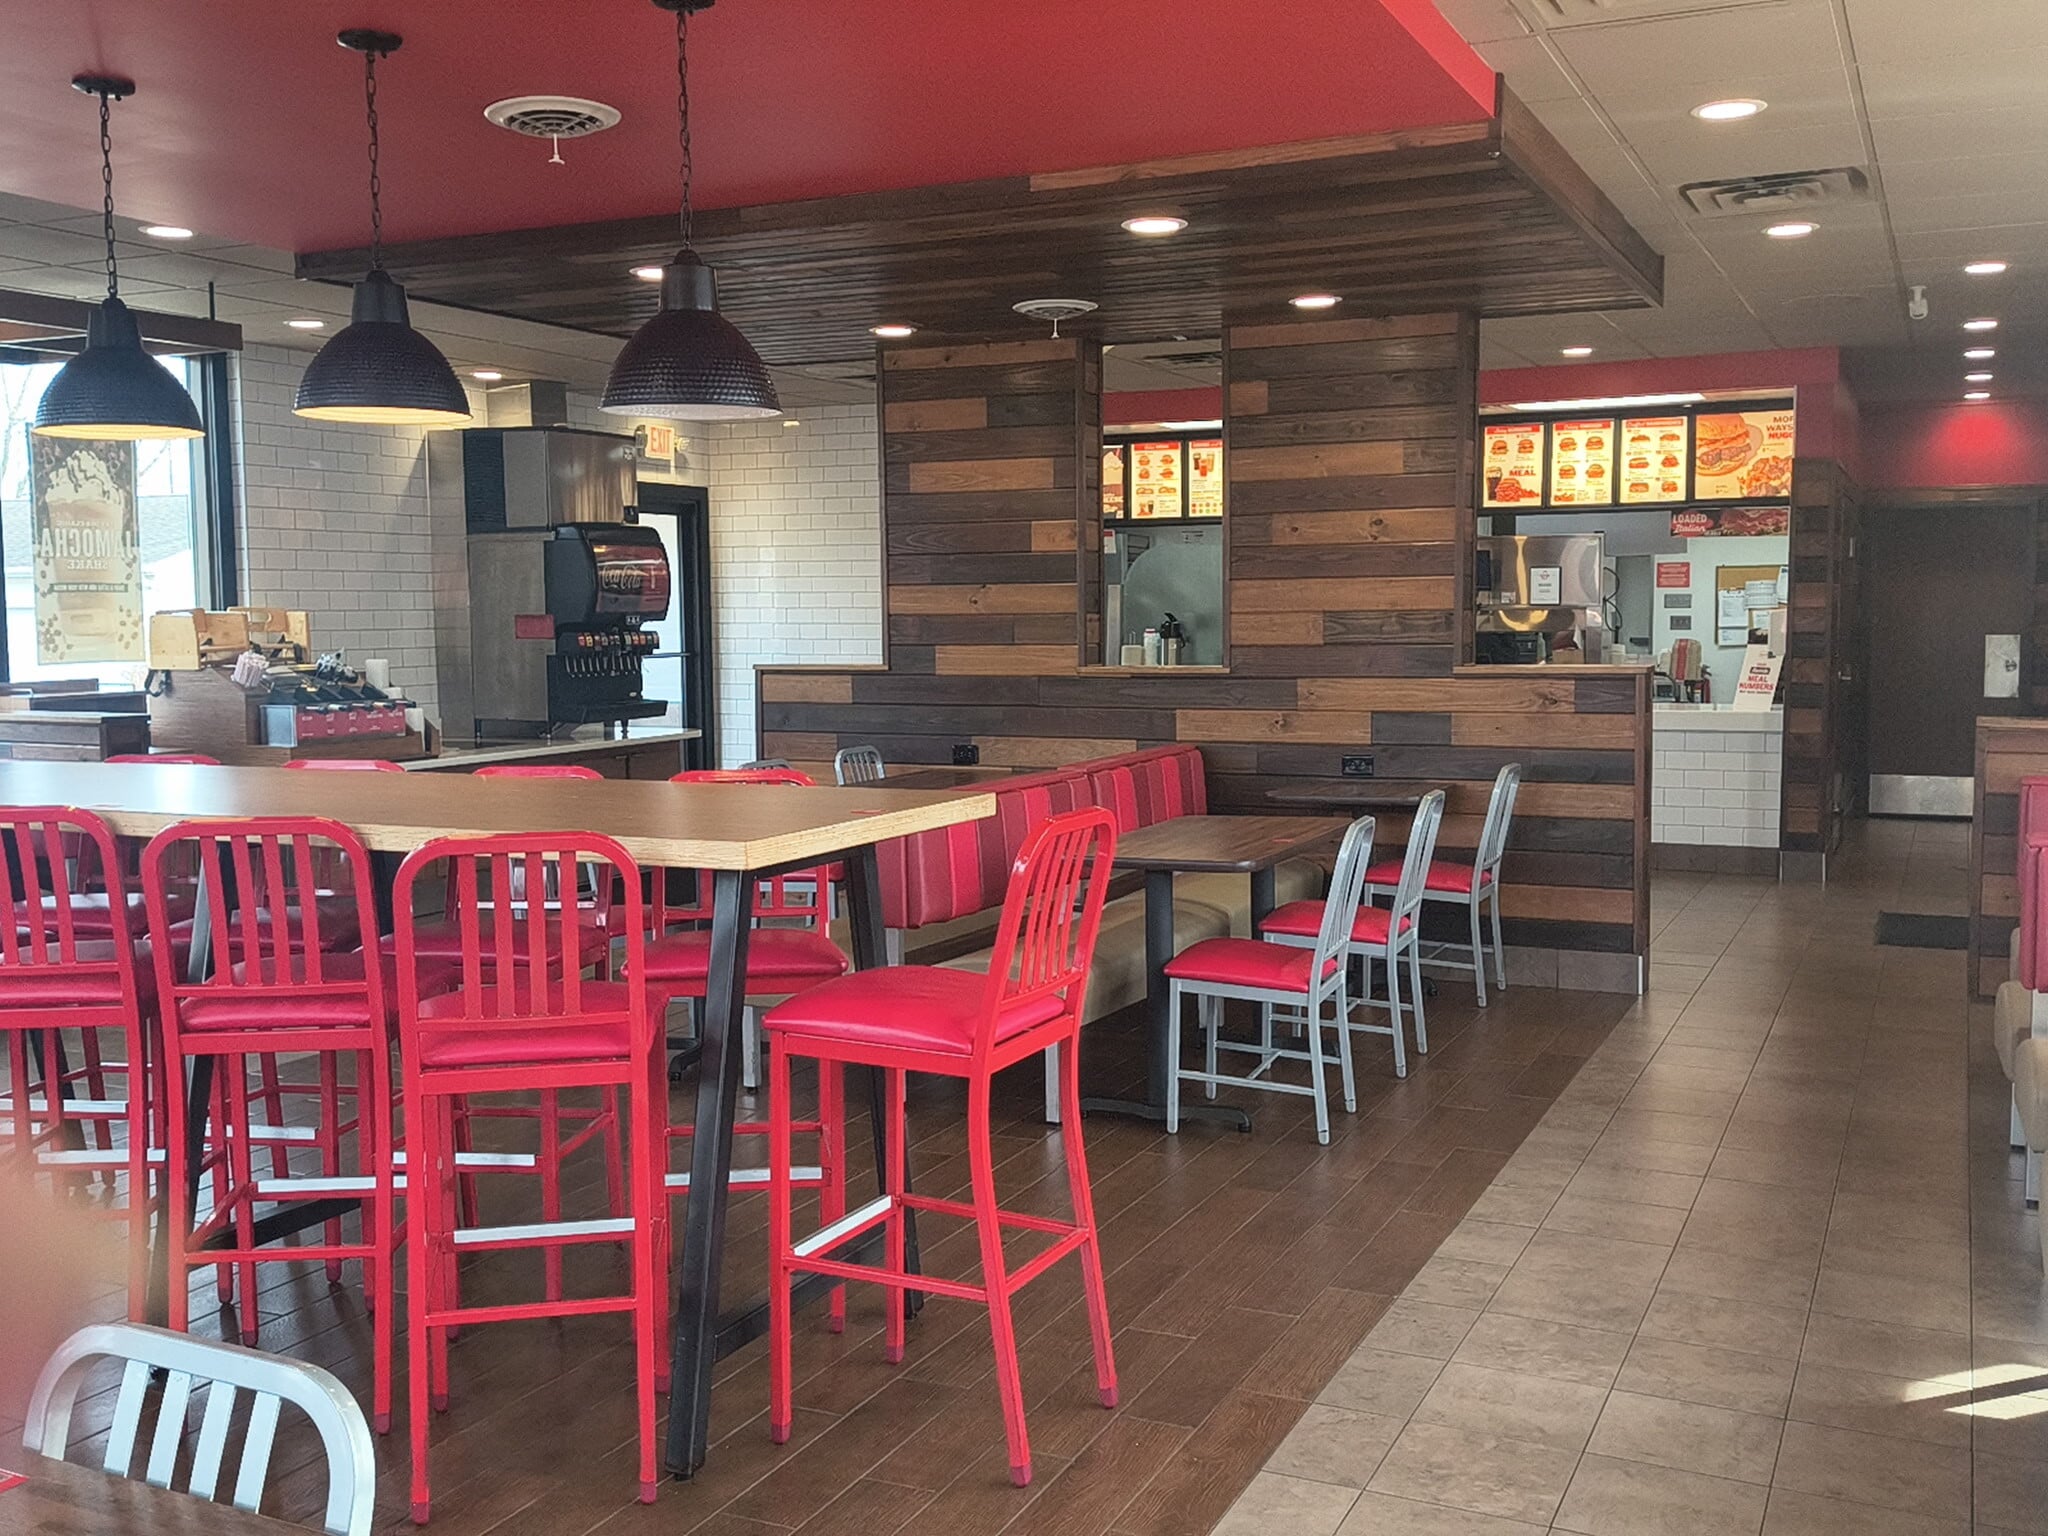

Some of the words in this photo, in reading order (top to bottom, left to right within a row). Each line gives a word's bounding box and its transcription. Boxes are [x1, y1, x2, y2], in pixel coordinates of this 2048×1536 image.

[650, 427, 672, 454] EXIT
[1508, 469, 1536, 477] MEAL
[1672, 512, 1708, 524] LOADED
[1747, 675, 1768, 683] MEAL
[1738, 683, 1775, 691] NUMBERS
